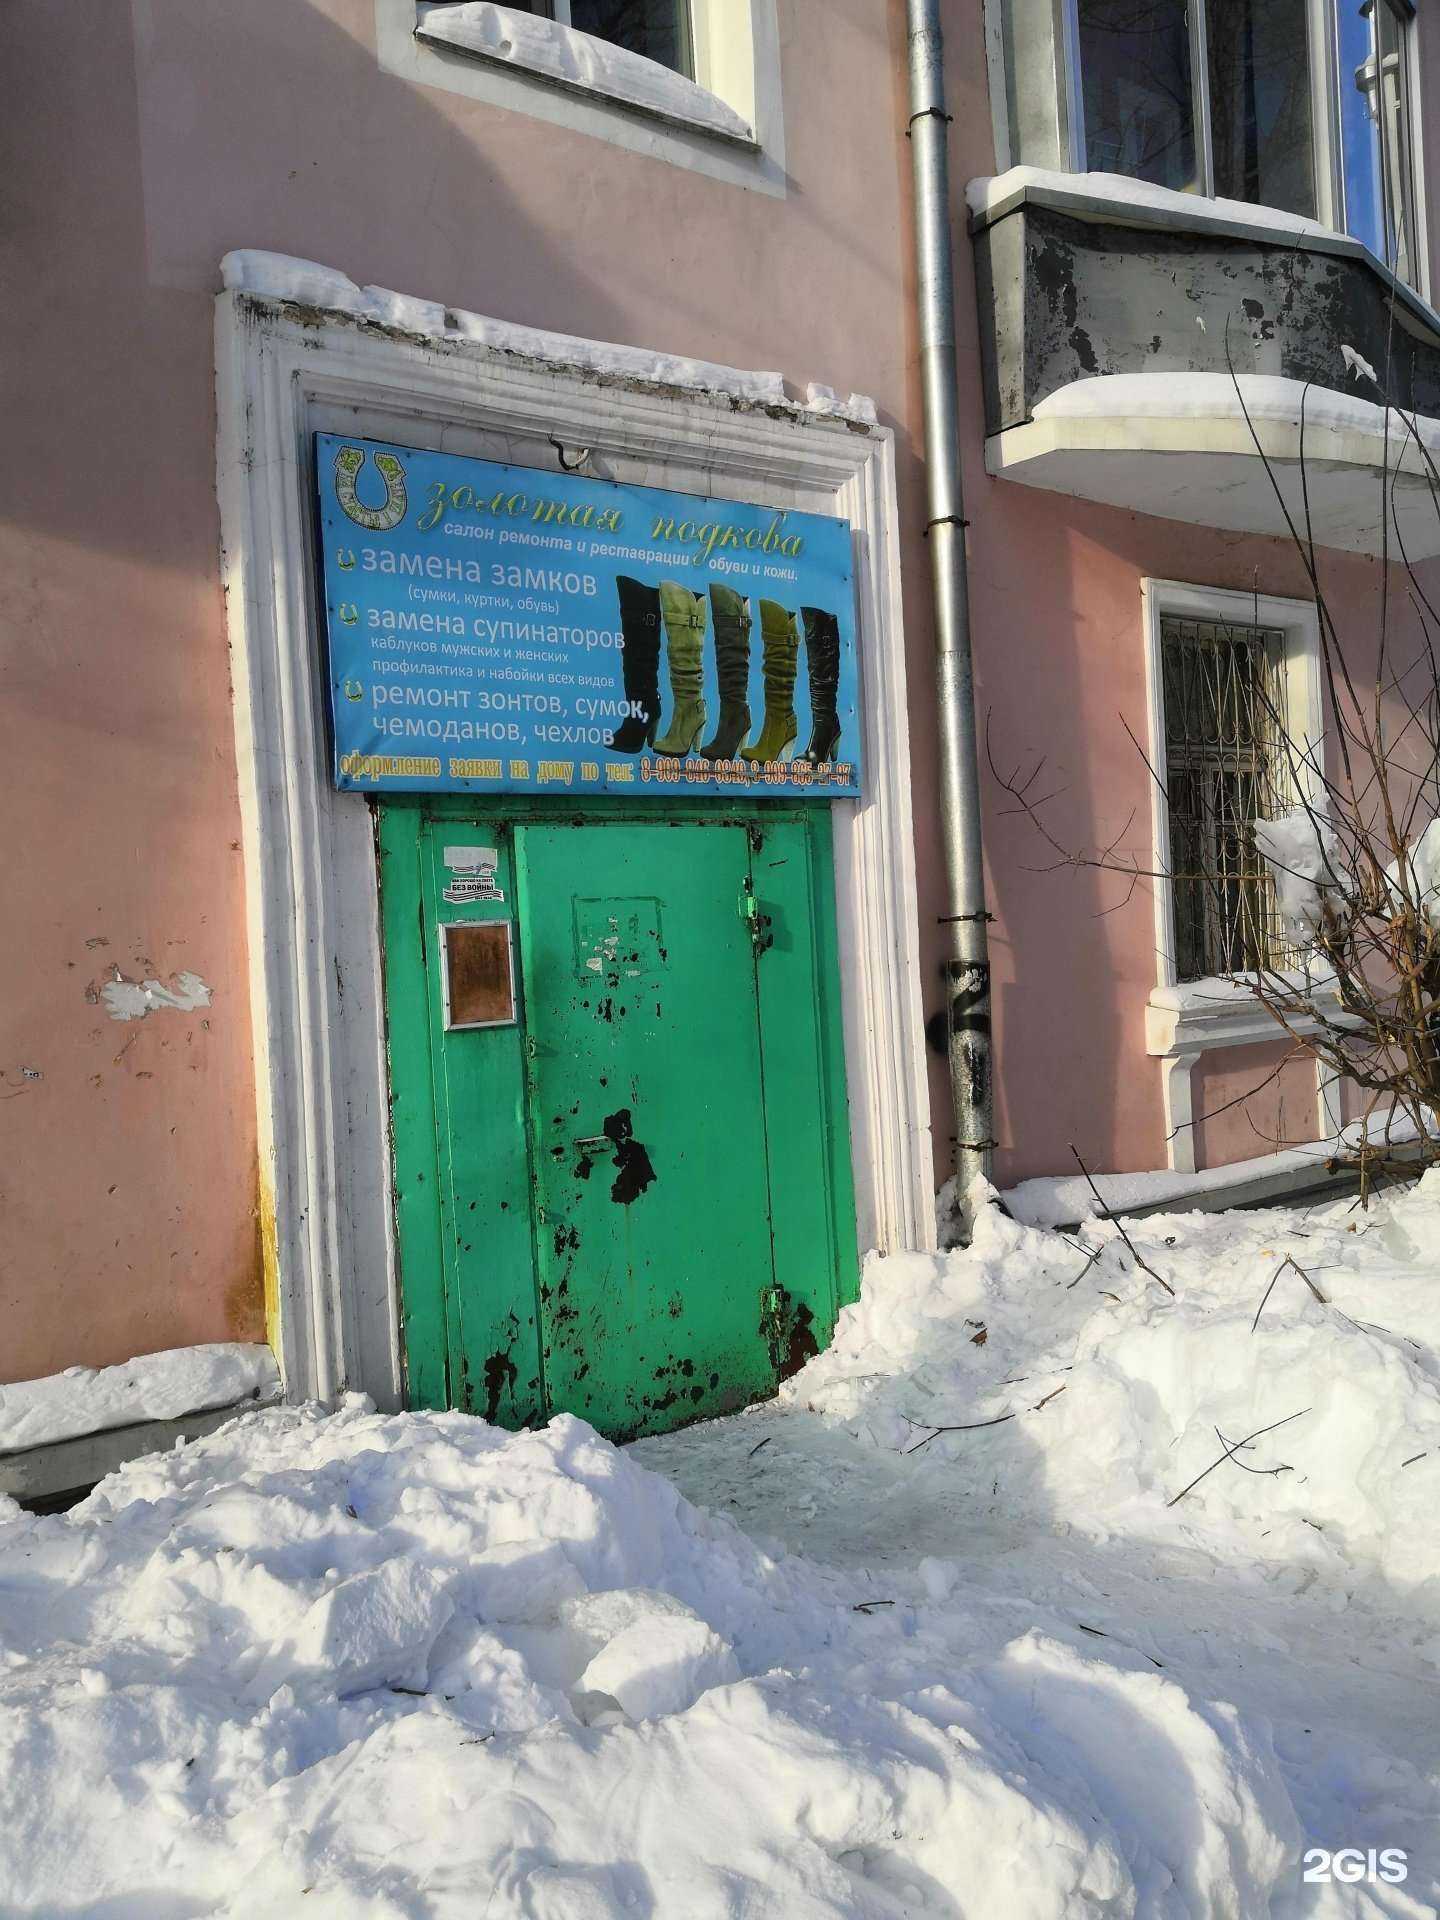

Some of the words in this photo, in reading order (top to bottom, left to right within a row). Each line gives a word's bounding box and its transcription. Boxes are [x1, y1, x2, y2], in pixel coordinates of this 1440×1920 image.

[416, 482, 622, 532] золотая
[652, 511, 805, 566] подкова
[444, 522, 495, 540] салон
[499, 529, 572, 551] ремонта
[577, 541, 586, 552] и
[590, 543, 689, 566] реставрации
[709, 556, 748, 574] обуви
[752, 564, 760, 575] и
[763, 566, 798, 580] кожи.
[361, 548, 480, 583] замена
[491, 563, 597, 596] замков
[408, 583, 460, 605] (сумки,
[464, 593, 514, 608] куртки,
[517, 597, 559, 615] обувь)
[367, 608, 465, 635] замена
[474, 617, 625, 652] супинаторов
[371, 635, 437, 653] каблуков
[441, 643, 500, 657] мужских
[503, 649, 511, 659] и
[515, 649, 569, 663] женских
[372, 659, 473, 677] профилактика
[477, 669, 485, 678] и
[489, 667, 544, 682] набойки
[548, 672, 575, 683] всех
[578, 675, 615, 688] видов
[372, 683, 470, 709] ремонт
[479, 691, 567, 717] зонтов,
[575, 697, 649, 722] сумок,
[373, 717, 527, 746] чемоданов,
[534, 724, 615, 746] чехлов
[340, 750, 441, 782] оформление
[450, 756, 502, 778] заявки
[510, 759, 529, 778] на
[537, 760, 573, 785] дому
[581, 763, 598, 780] по
[467, 882, 494, 891] ВОЙНЫ
